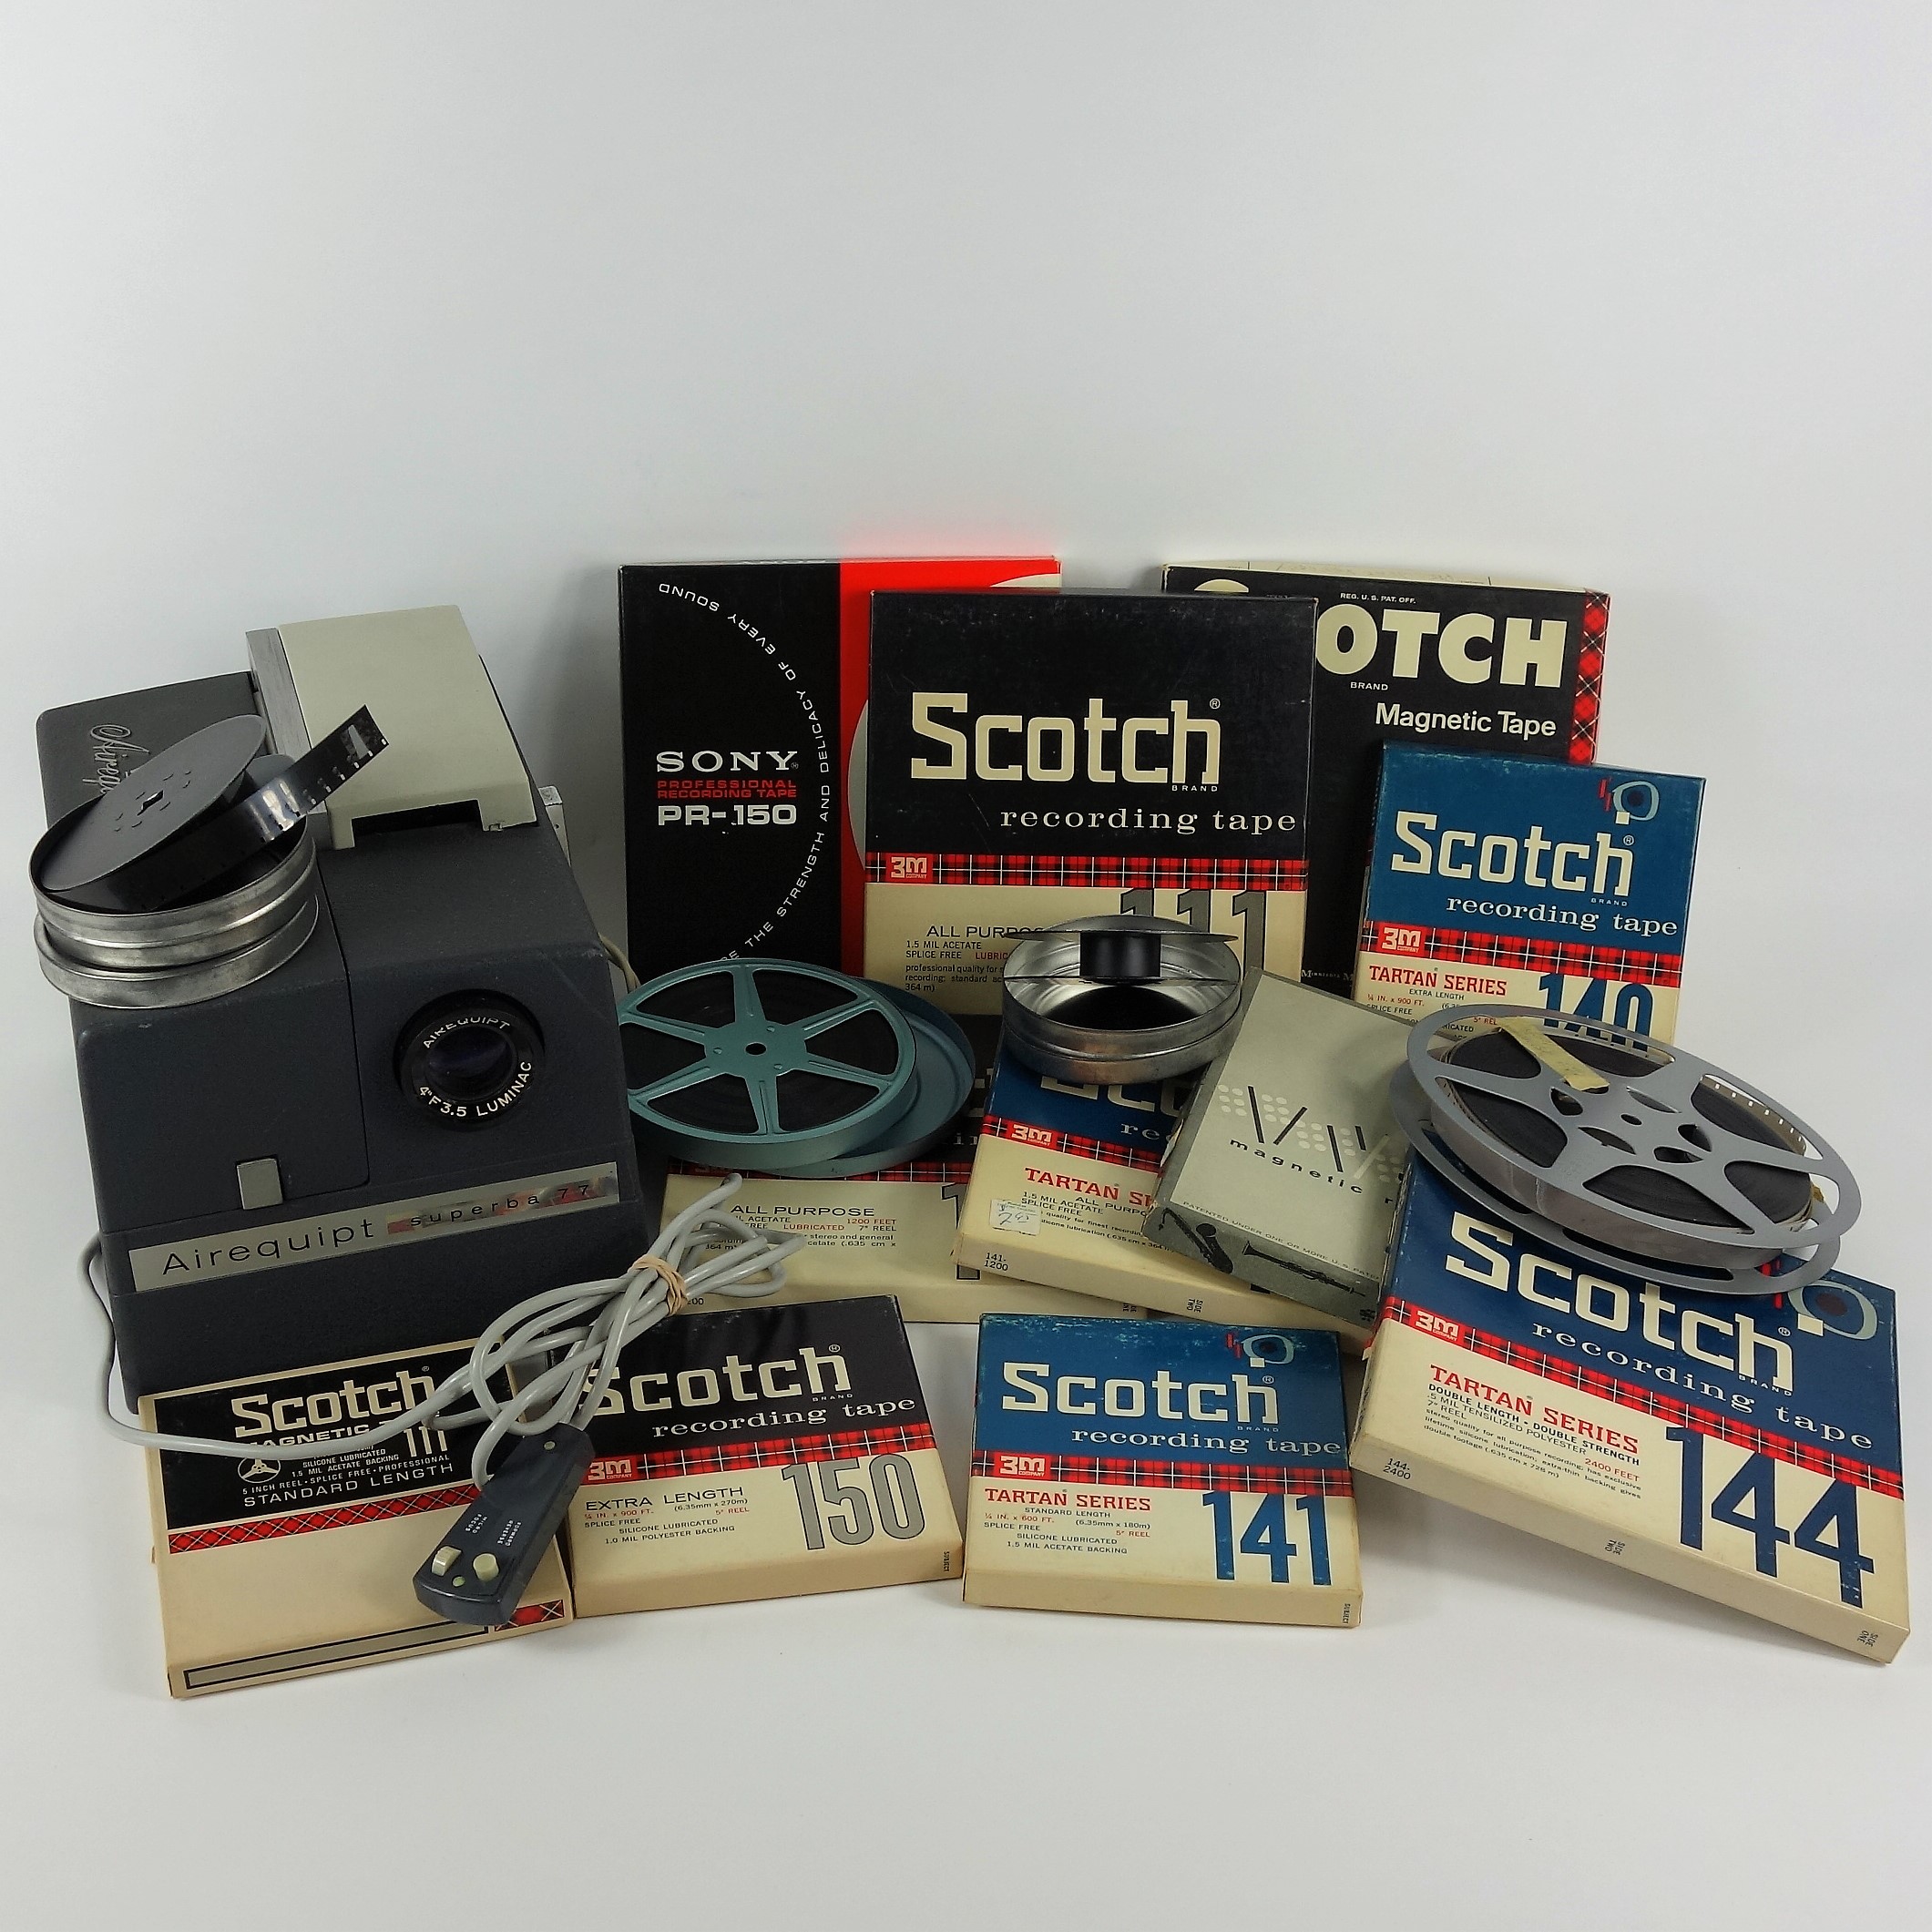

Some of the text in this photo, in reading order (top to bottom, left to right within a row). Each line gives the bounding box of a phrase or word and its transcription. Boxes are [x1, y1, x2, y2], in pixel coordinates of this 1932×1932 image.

[1316, 604, 1567, 688] OTCH
[1350, 682, 1388, 690] BRAND
[1375, 702, 1556, 741] Magnetic Tape
[911, 691, 1221, 784] Scotch
[657, 751, 798, 772] SONY
[659, 583, 830, 947] THE STRENGTH AND DELICACY OF EVERY SOUND
[658, 780, 796, 789] PROFESSIONAL
[658, 790, 797, 799] RECORDING TAPE
[658, 804, 797, 825] PR-150
[1000, 808, 1295, 835] recording tape
[1391, 811, 1633, 896] Scotch
[891, 856, 927, 878] 3M
[1590, 897, 1628, 906] BRAND
[1446, 897, 1678, 937] recording tape
[926, 925, 1043, 938] ALL PURPO
[1382, 927, 1421, 950] 3M
[905, 950, 1008, 960] SPLICE FREE LUBRIC
[923, 941, 940, 949] MIL
[943, 941, 981, 950] ACETATE
[905, 964, 956, 974] professional
[956, 965, 985, 975] quality
[1369, 965, 1437, 987] TARTAN
[1444, 975, 1508, 996] SERIES
[905, 983, 921, 991] 364
[1409, 988, 1465, 1001] EXTRA LENGTH
[1395, 1007, 1413, 1016] FREE
[423, 1017, 510, 1048] AIREQUIPT
[475, 1061, 531, 1117] LUMINAC
[1230, 1139, 1364, 1195] magnetic
[1025, 1167, 1119, 1201] TARTAN
[731, 1205, 874, 1216] ALL PURPOSE
[1021, 1198, 1060, 1212] SPLICE
[1063, 1207, 1082, 1217] FREE
[1023, 1191, 1103, 1215] 1.5 MIL ACETATE
[1075, 1196, 1147, 1217] ALL PURPO
[162, 1183, 590, 1275] Airequipt superba 77
[984, 1261, 1008, 1272] 1200
[1446, 1211, 1793, 1391] Scotch
[1416, 1311, 1458, 1337] 3M
[579, 1347, 851, 1416] Scotch
[1532, 1323, 1872, 1449] recording tape
[1738, 1375, 1793, 1396] BRAND
[231, 1370, 435, 1438] Scotch
[813, 1393, 854, 1402] BRAND
[1002, 1362, 1279, 1425] Scotch
[652, 1398, 915, 1437] recording tape
[1430, 1365, 1638, 1454] TARTAN SERIES
[248, 1424, 370, 1446] AGNETIC
[1429, 1384, 1640, 1466] DOUBLE LENGTH DOUBLE STRENGTH
[1440, 1396, 1587, 1456] MIL TENSILIZED POLYESTER
[1072, 1428, 1341, 1457] recording tape
[1440, 1405, 1640, 1482] REEL 2400 FEET
[302, 1457, 338, 1468] SILICONE
[340, 1448, 386, 1463] LUBRICATED
[308, 1467, 323, 1476] MIL
[327, 1461, 361, 1472] ACETATE
[365, 1454, 399, 1467] BACKING
[999, 1455, 1045, 1475] 3M
[251, 1484, 275, 1494] INCH
[279, 1479, 303, 1489] REEL
[311, 1474, 343, 1485] SPLICE
[348, 1468, 372, 1478] FREE
[379, 1455, 450, 1473] PROFESSIONAL
[1383, 1465, 1411, 1480] 2400
[244, 1463, 453, 1507] STANDARD LENGTH
[586, 1487, 743, 1511] EXTRA LENGTH
[782, 1454, 925, 1550] 150
[985, 1488, 1151, 1512] TARTAN SERIES
[585, 1518, 640, 1528] SPLICE FREE
[1025, 1508, 1110, 1518] STANDARD LENGTH
[1666, 1425, 1875, 1609] 144
[619, 1518, 718, 1534] SILICONE LUBRICATED
[642, 1530, 691, 1540] POLYESTER
[695, 1526, 735, 1535] BACKING
[984, 1522, 1015, 1530] SPLICE
[1202, 1490, 1332, 1585] 141
[1017, 1533, 1118, 1545] SILICONE LUBRICATED
[1043, 1543, 1083, 1552] ACETATE
[1088, 1546, 1128, 1554] BACKING
